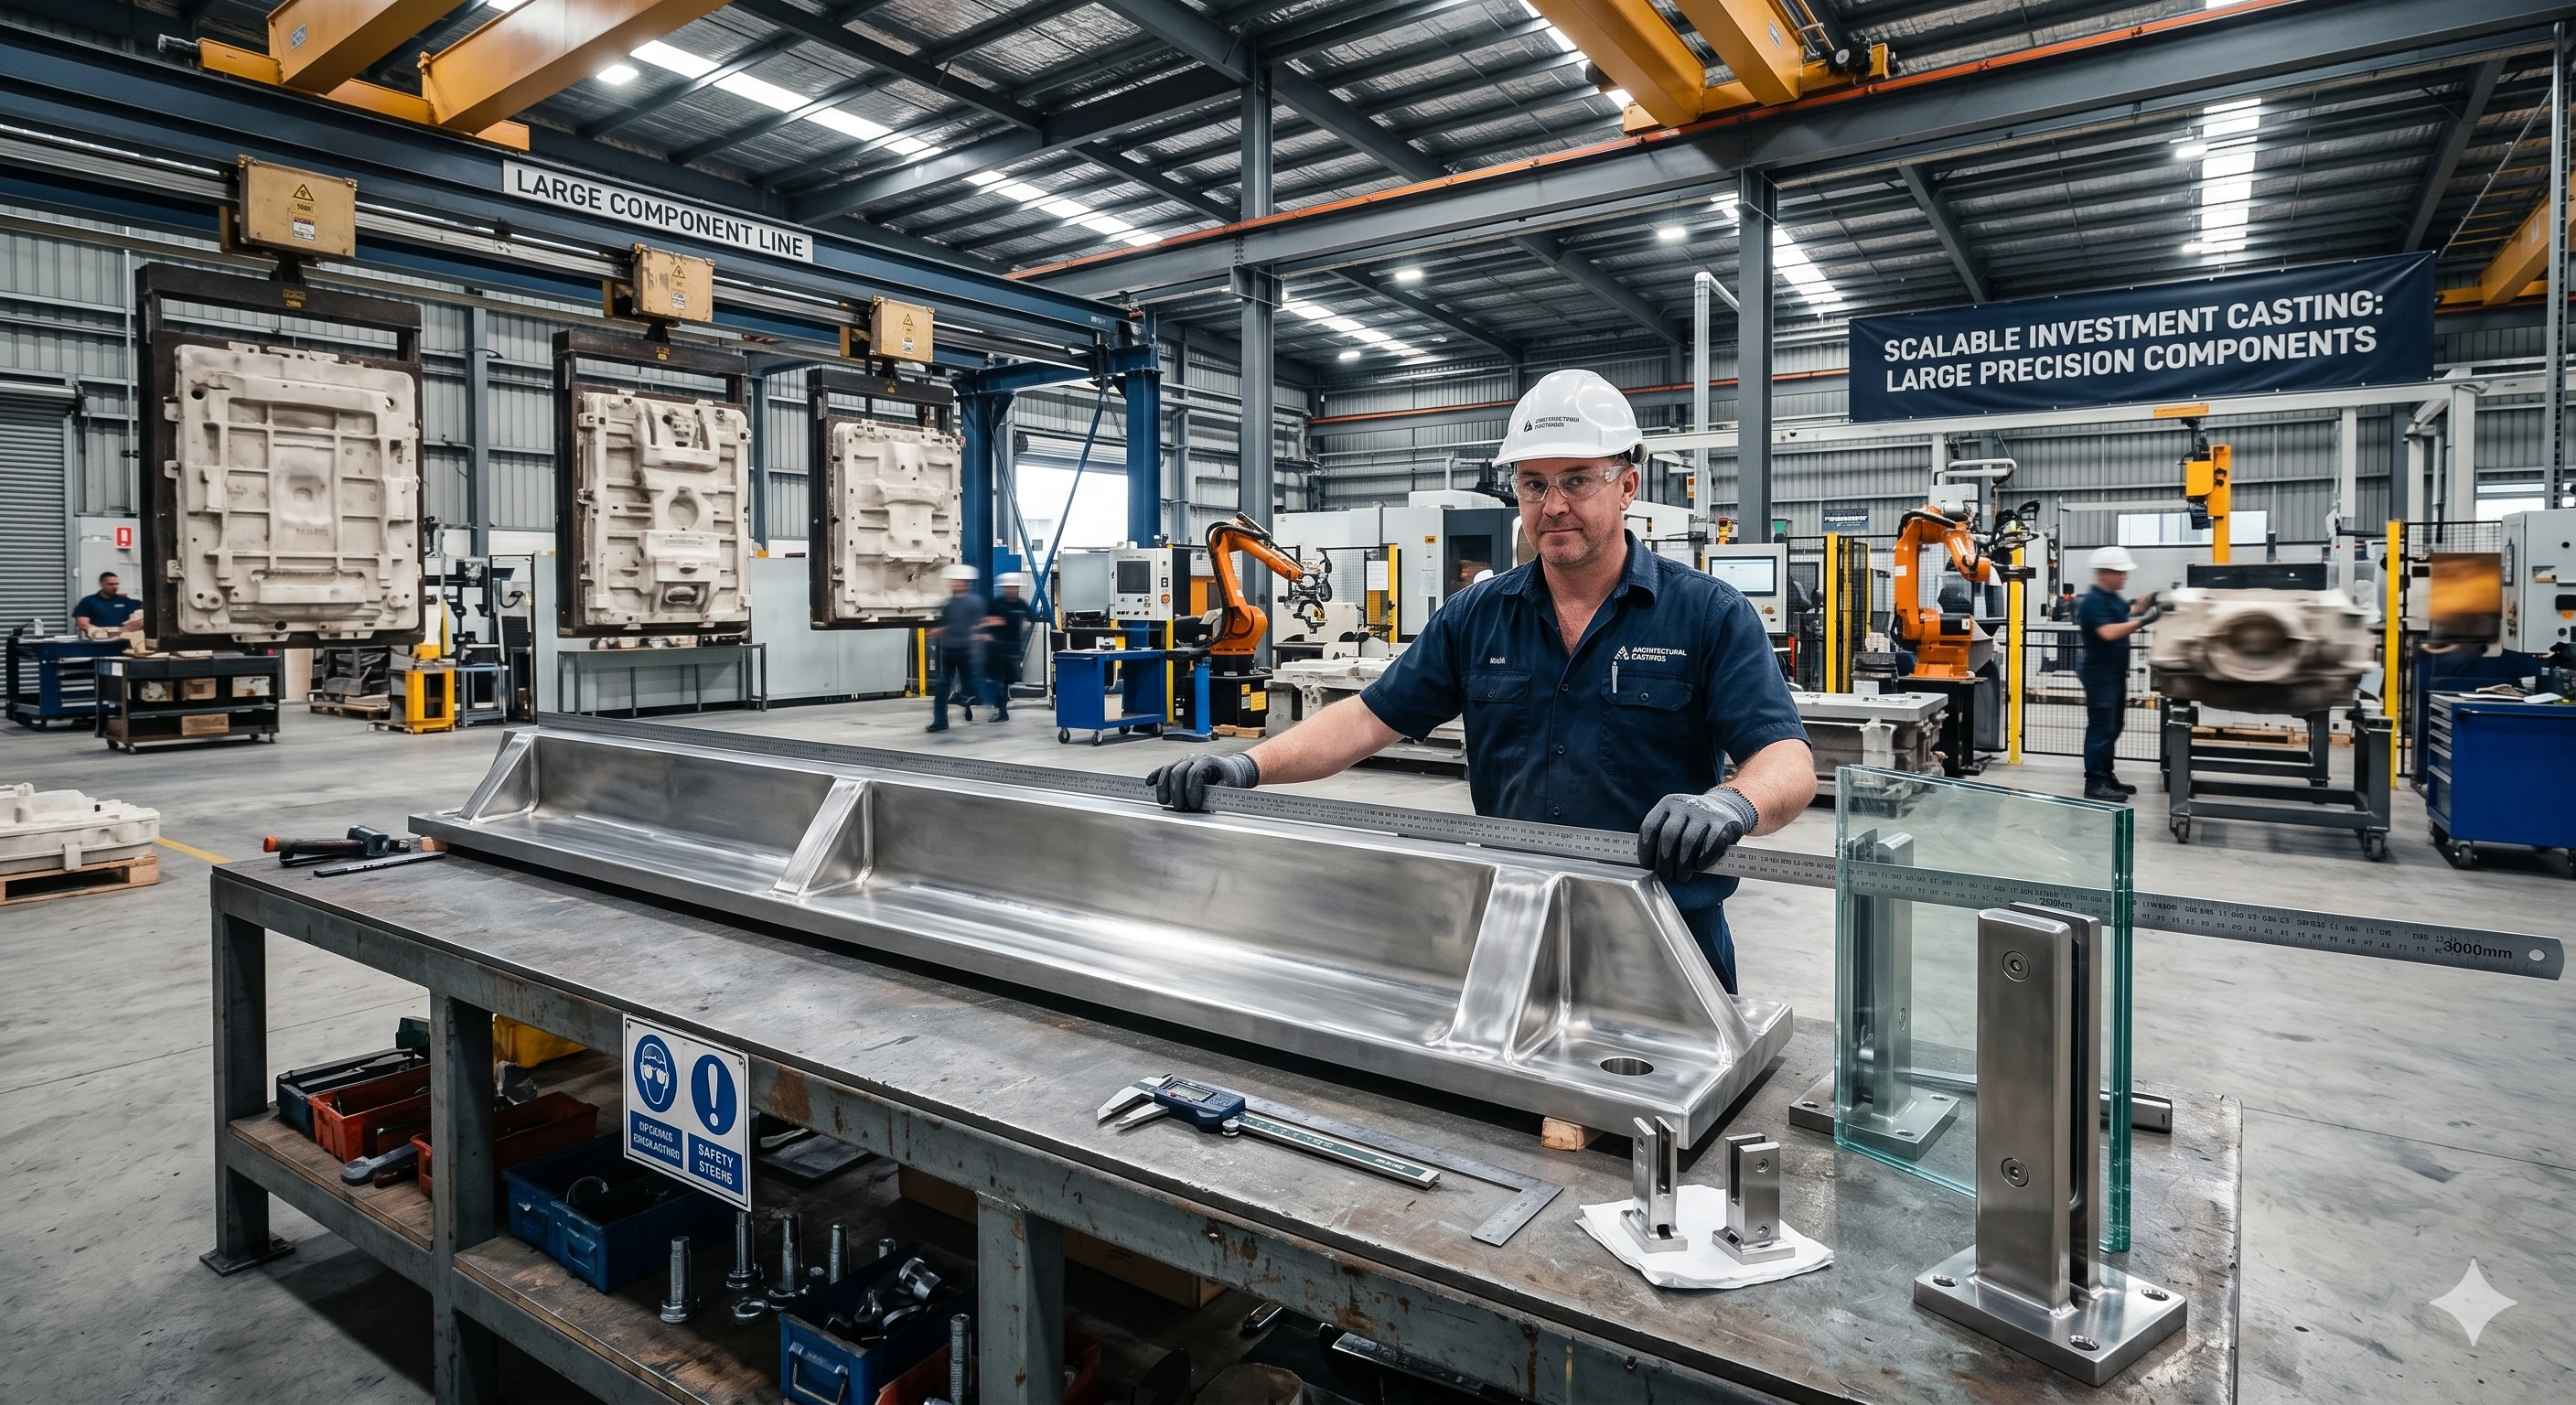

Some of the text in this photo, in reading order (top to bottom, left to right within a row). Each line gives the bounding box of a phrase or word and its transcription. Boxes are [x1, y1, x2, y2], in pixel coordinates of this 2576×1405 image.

[517, 169, 803, 258] LARGE COMPONENT LINE
[1884, 290, 2383, 362] SCALABLE INVESTMENT CASTING:
[1886, 326, 2377, 392] LARGE PRECISION COMPONENTS
[2443, 940, 2512, 960] 3000mm
[698, 1143, 734, 1168] SAFETY
